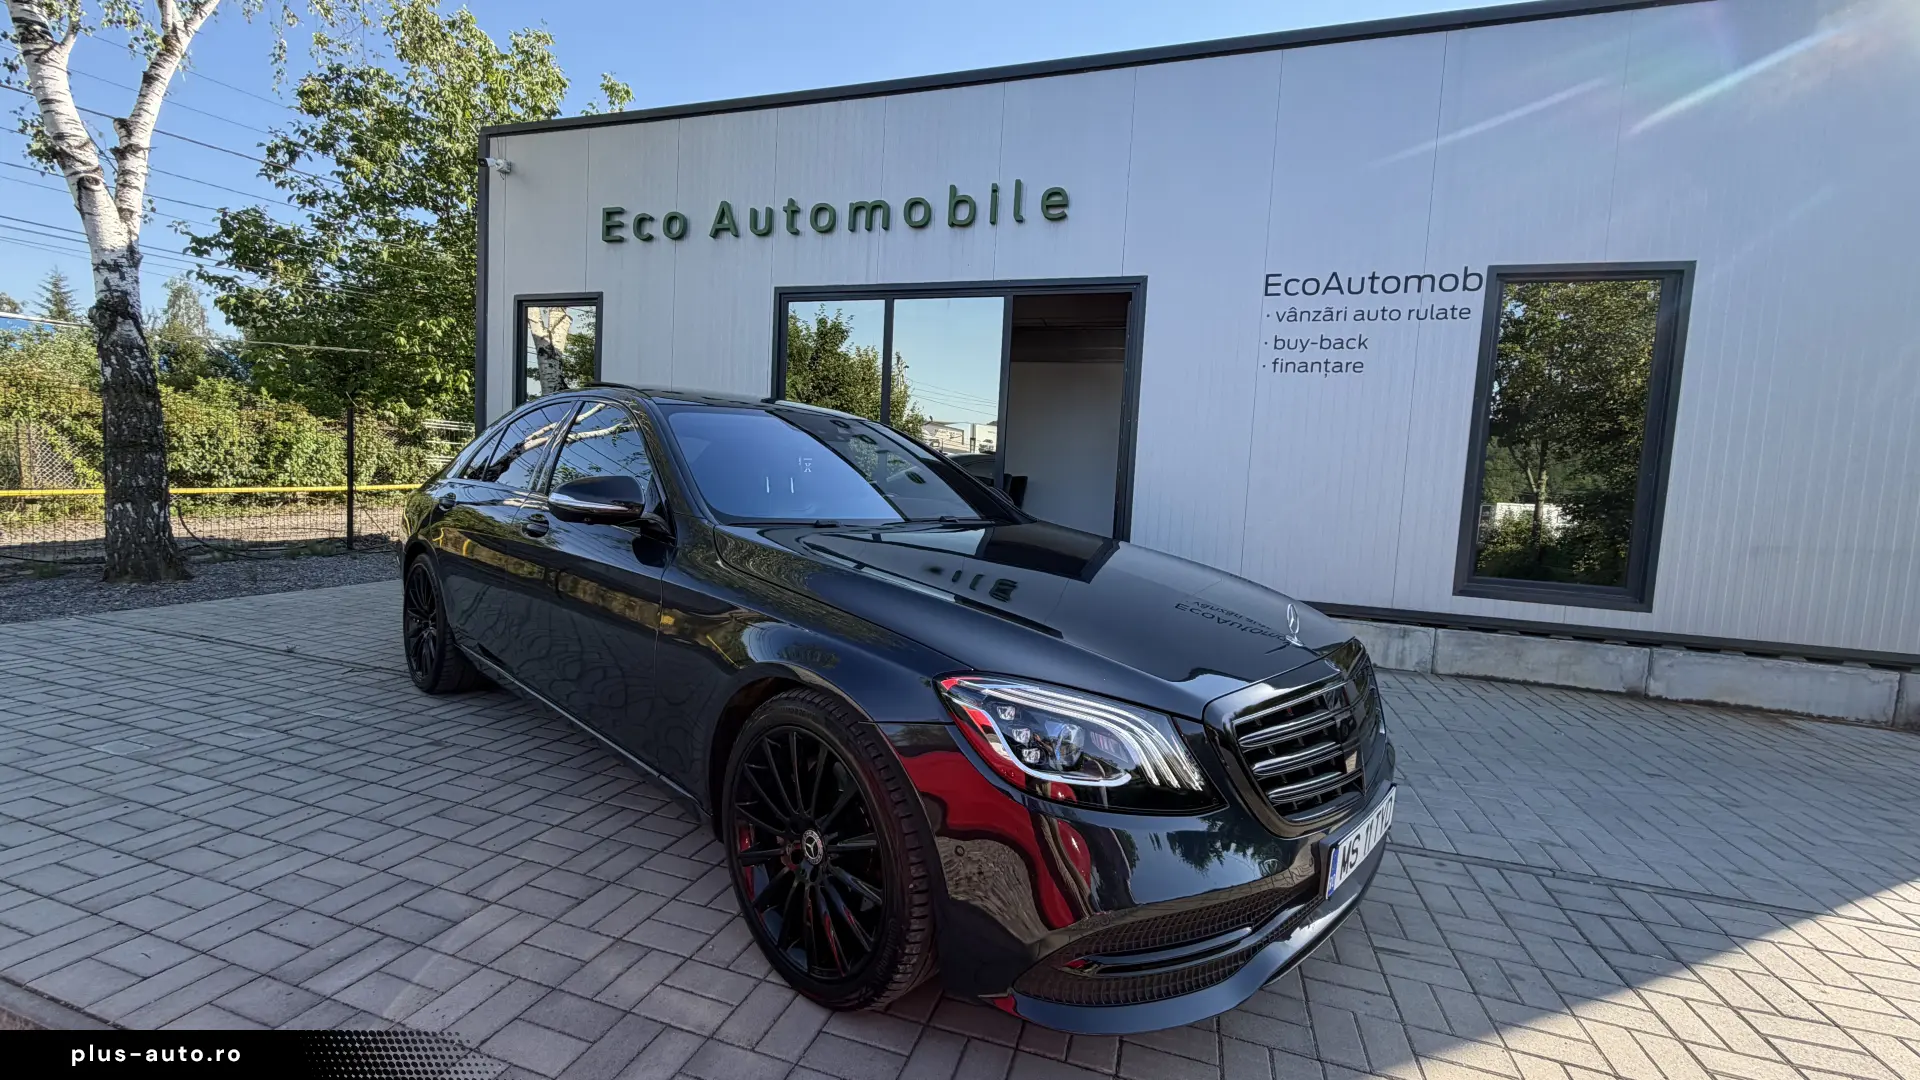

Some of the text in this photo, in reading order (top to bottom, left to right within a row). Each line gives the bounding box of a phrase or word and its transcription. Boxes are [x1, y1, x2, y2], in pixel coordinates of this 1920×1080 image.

[601, 178, 1071, 243] Eco Automobile
[1264, 265, 1484, 297] EcoAutomob
[1353, 305, 1402, 322] auto
[1407, 304, 1472, 321] rulate
[1273, 333, 1369, 353] buy-back
[1339, 834, 1361, 880] MS
